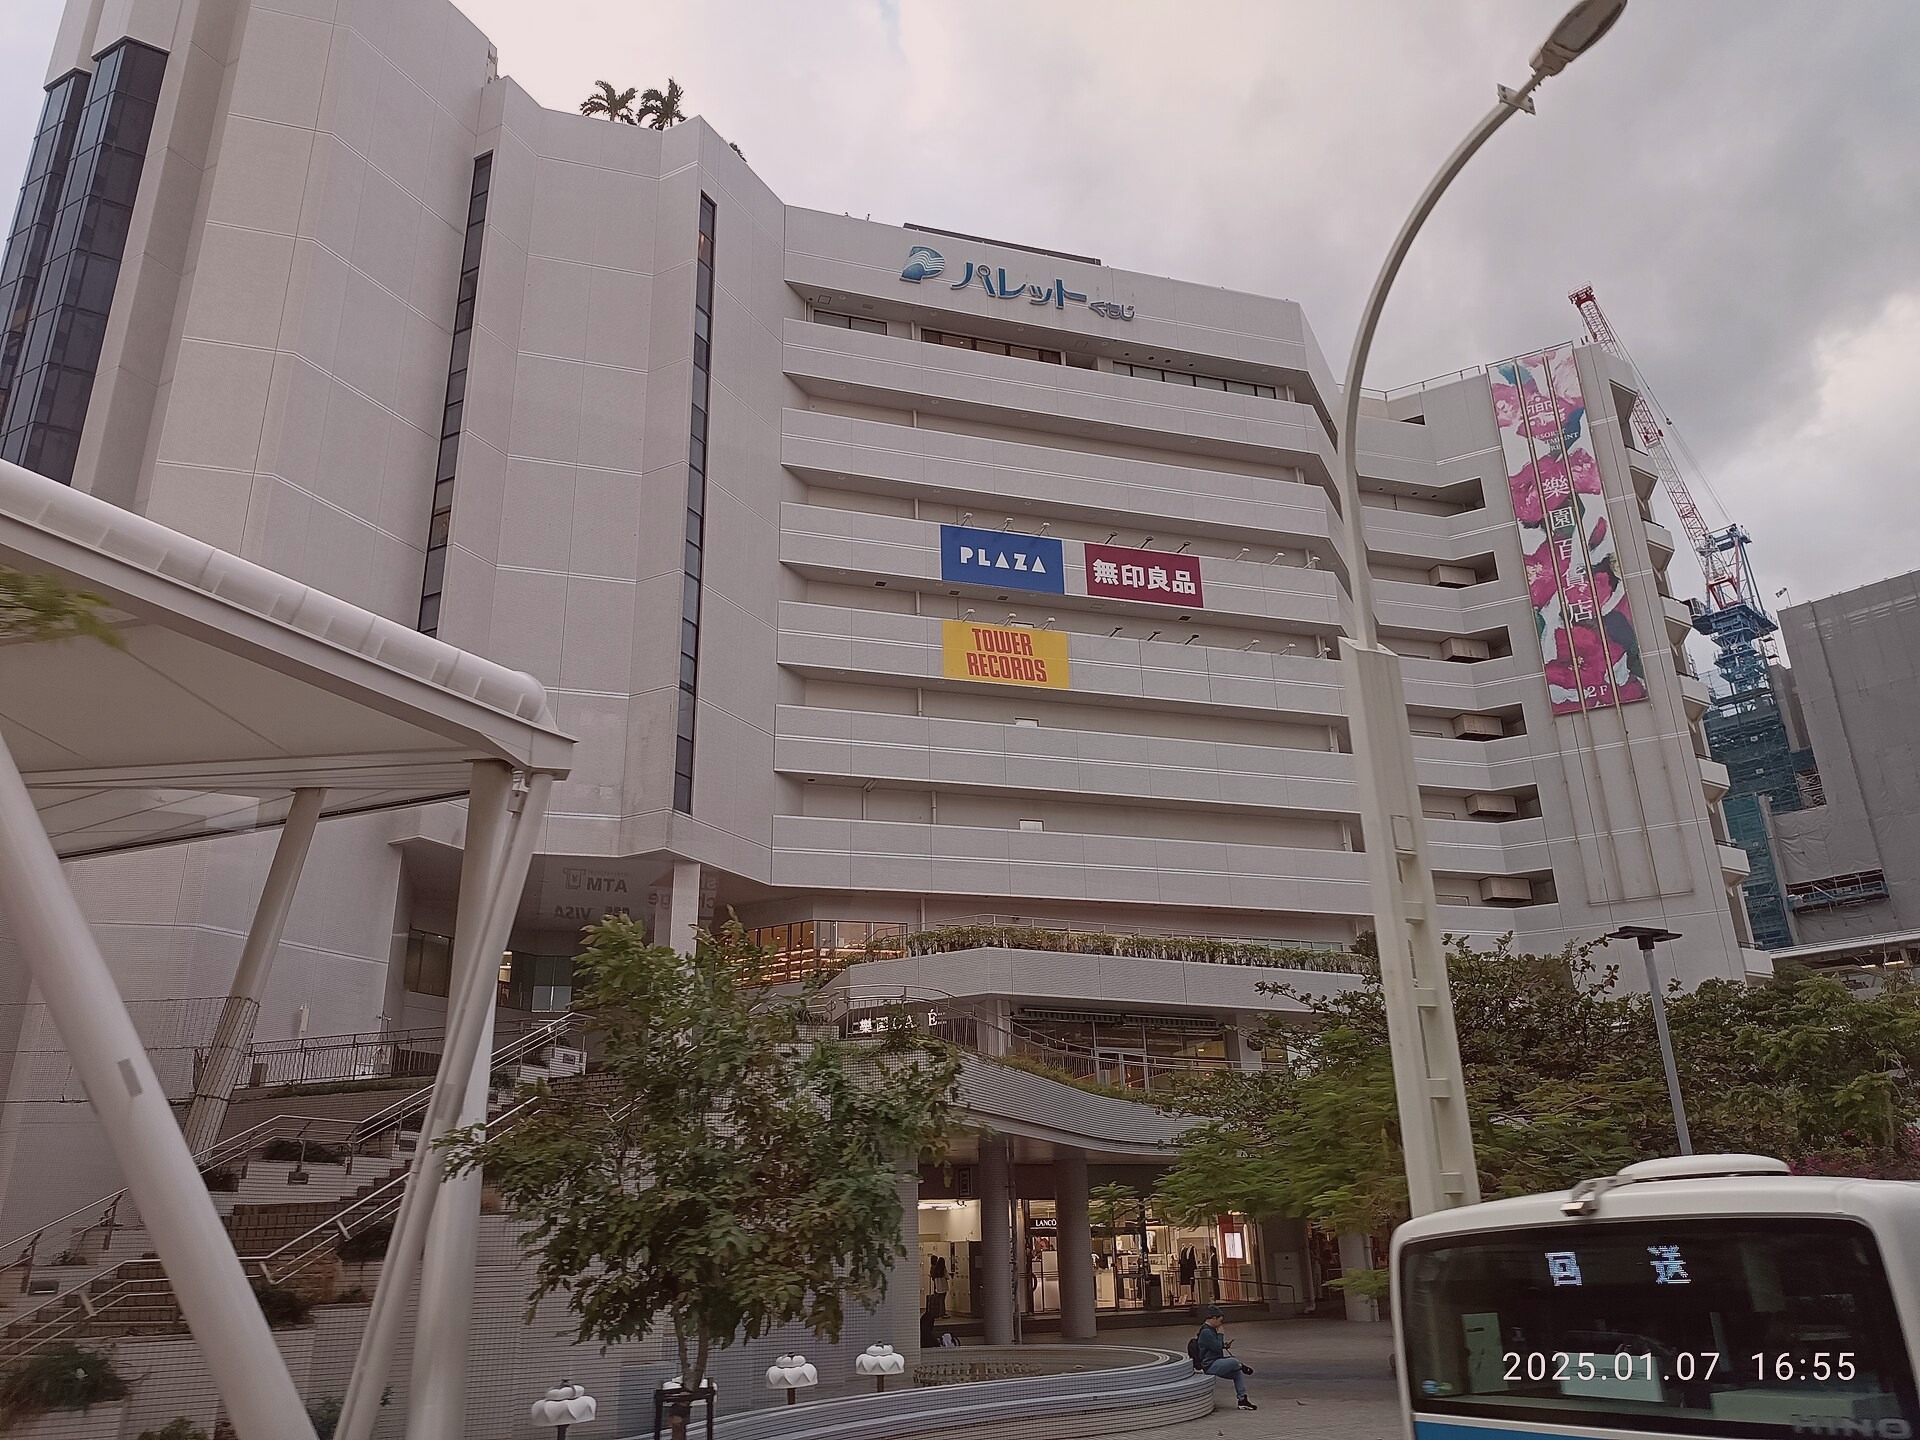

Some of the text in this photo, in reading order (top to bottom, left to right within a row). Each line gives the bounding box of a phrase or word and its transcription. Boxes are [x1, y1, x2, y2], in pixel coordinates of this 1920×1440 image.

[960, 546, 1047, 574] PLAZA
[1092, 559, 1197, 595] 無印良品
[971, 628, 1033, 657] TOWER
[966, 652, 1048, 683] RECORDS
[1587, 685, 1608, 698] 2F
